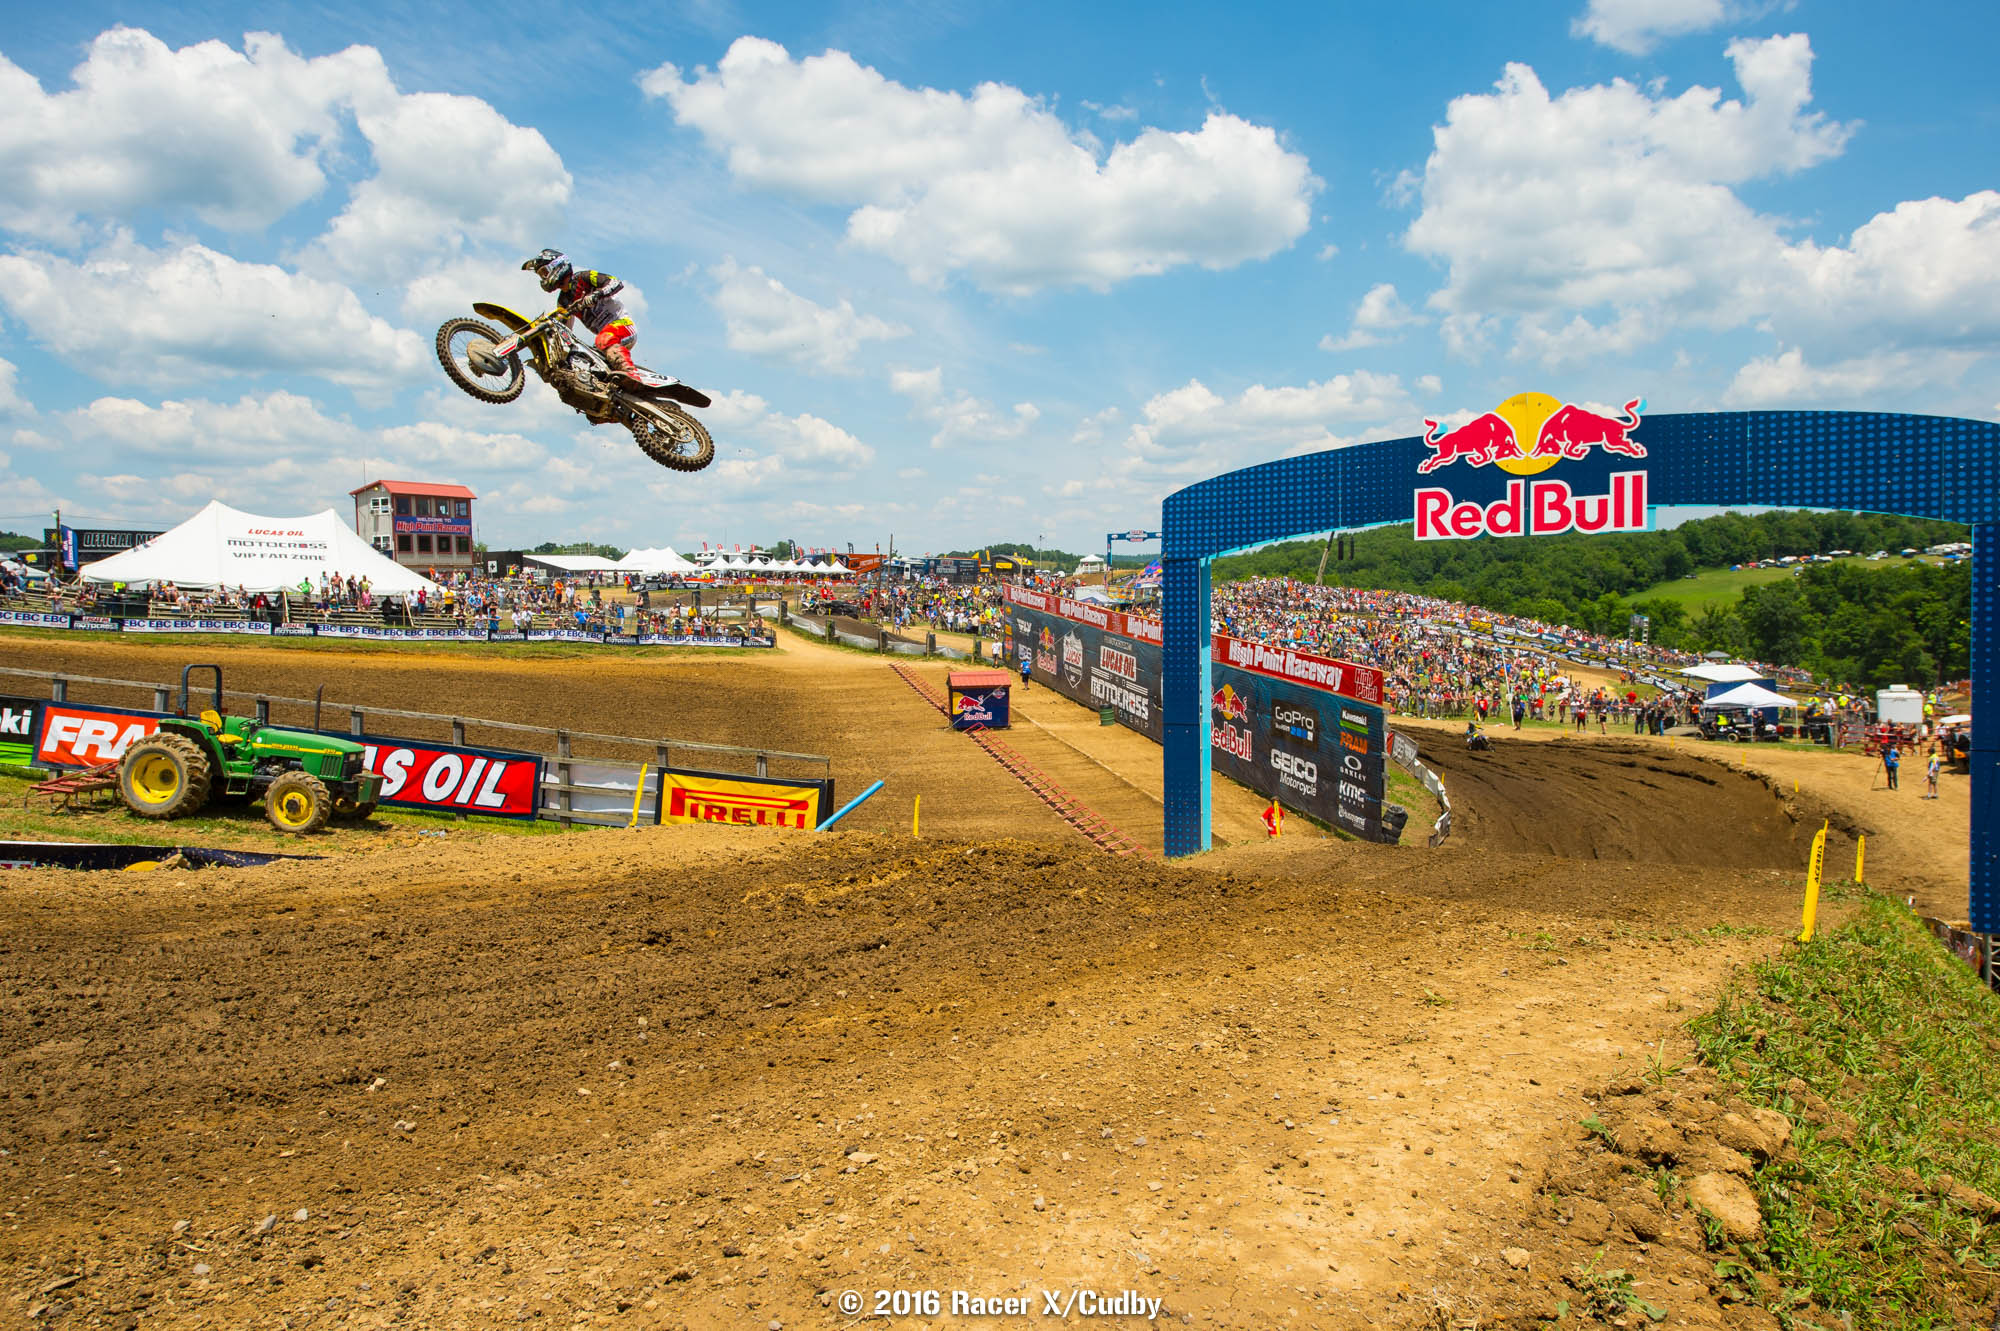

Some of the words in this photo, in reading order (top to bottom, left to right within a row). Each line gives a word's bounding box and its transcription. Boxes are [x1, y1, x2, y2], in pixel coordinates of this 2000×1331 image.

[1415, 480, 1524, 540] Red
[1530, 470, 1647, 536] Bull
[83, 532, 132, 547] OFFICIAL
[248, 528, 284, 536] LUCAS
[397, 520, 414, 532] High
[416, 521, 435, 531] Point
[437, 523, 470, 535] Raceway
[227, 539, 328, 549] MOTOCROSS
[292, 553, 327, 561] ZONE
[15, 612, 41, 622] EBC
[43, 614, 69, 624] EBC
[124, 619, 146, 628] EBC
[150, 620, 171, 628] EBC
[174, 620, 196, 628] EBC
[200, 621, 221, 629] EBC
[224, 621, 245, 630] EBC
[248, 622, 269, 630] EBC
[1060, 598, 1071, 617] High
[1071, 602, 1084, 620] Point
[1084, 606, 1108, 630] Raceway
[318, 624, 337, 632] EBC
[362, 627, 381, 635] EBC
[384, 628, 403, 636] EBC
[586, 632, 603, 640] EBC
[692, 635, 708, 643] EBC
[725, 636, 741, 644] EBC
[1128, 615, 1143, 638] High
[1144, 620, 1162, 642] Point
[1102, 648, 1122, 673] LUCAS
[1123, 656, 1136, 679] OIL
[1229, 639, 1253, 667] High
[1254, 646, 1284, 674] Point
[1285, 652, 1343, 691] Raceway
[1354, 668, 1374, 687] High
[1090, 676, 1149, 720] MOTOCROSS
[1356, 682, 1378, 702] Point
[0, 708, 32, 735] ki
[964, 712, 979, 721] Red
[979, 711, 992, 720] Bull
[1275, 706, 1314, 730] GoPro
[1342, 709, 1368, 726] Kawasaki
[42, 714, 160, 760] FRA
[1228, 723, 1252, 762] Bull
[1340, 731, 1368, 756] FRAM
[363, 745, 415, 797] S
[422, 753, 507, 808] OIL
[1270, 748, 1318, 784] GEICO
[1340, 765, 1367, 782] OAKLEY
[1280, 771, 1317, 797] Motorcycle
[1339, 779, 1366, 803] KMC
[670, 787, 809, 830] PIRELLI
